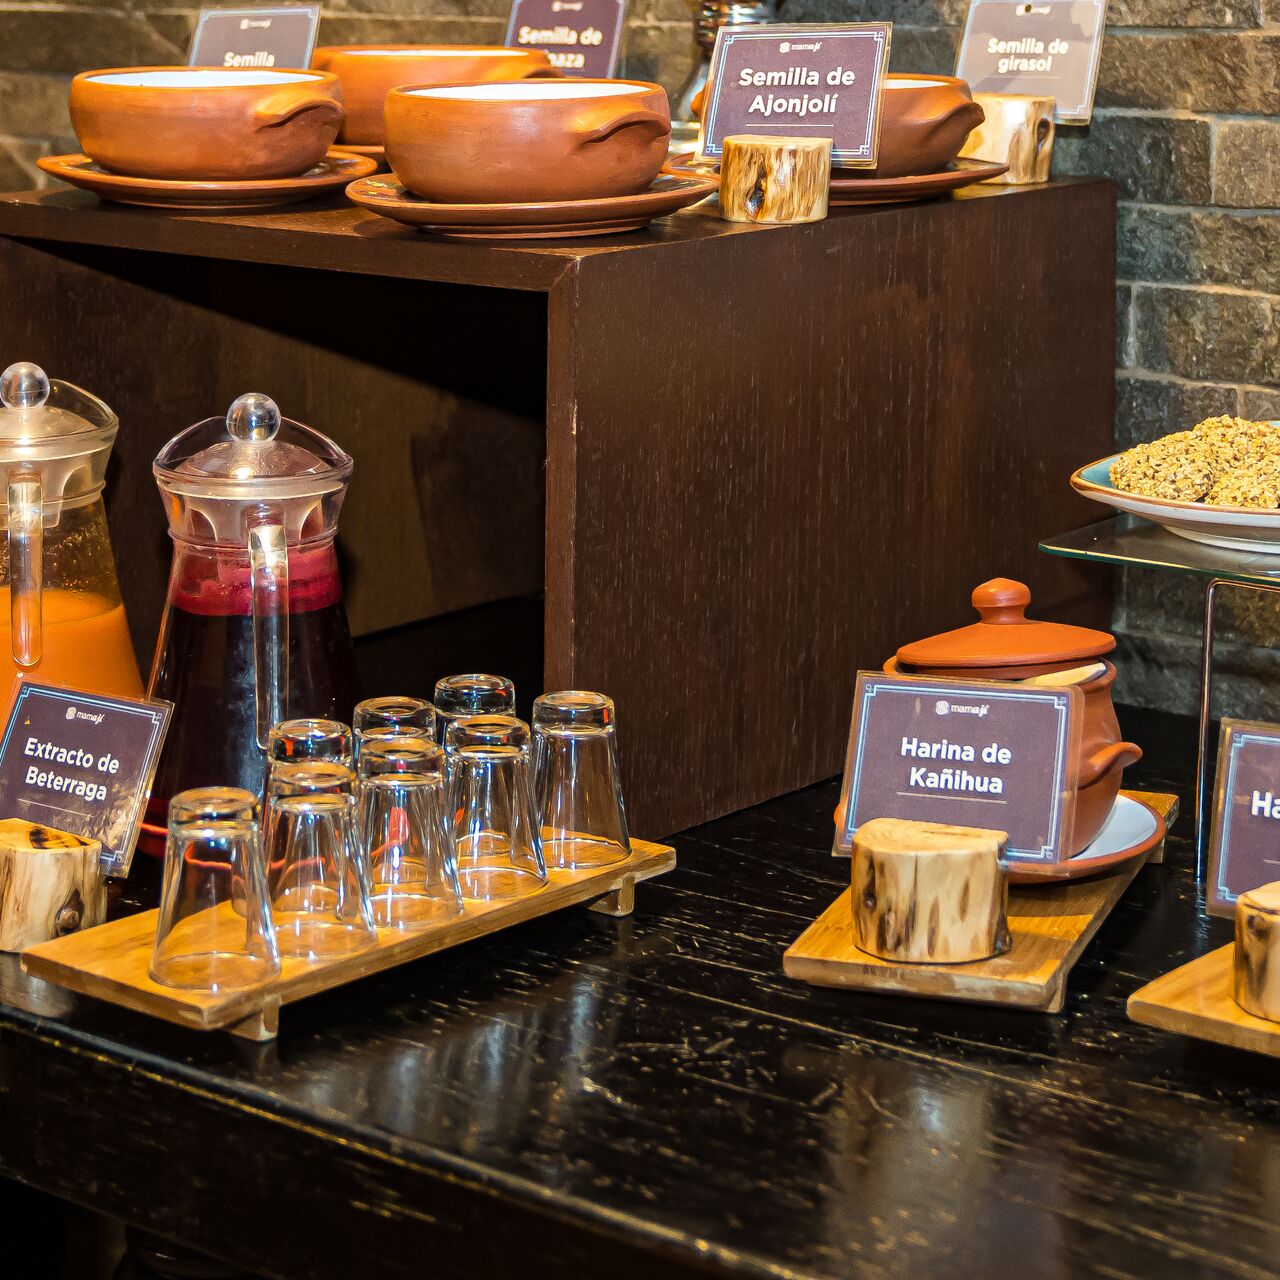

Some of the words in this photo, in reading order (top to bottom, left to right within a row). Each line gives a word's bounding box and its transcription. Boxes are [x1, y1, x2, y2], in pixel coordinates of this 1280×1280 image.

[518, 25, 577, 44] Semilla
[580, 26, 602, 45] de
[987, 37, 1044, 53] Semilla
[1047, 38, 1068, 54] de
[223, 51, 275, 66] Semilla
[997, 54, 1052, 73] girasol
[738, 66, 819, 85] Semilla
[826, 66, 855, 85] de
[747, 93, 838, 116] Ajonjolí
[24, 737, 93, 767] Extracto
[97, 753, 119, 773] de
[900, 736, 974, 761] Harina
[981, 742, 1011, 764] de
[25, 765, 107, 801] Beterraga
[909, 766, 1003, 793] Kañihua
